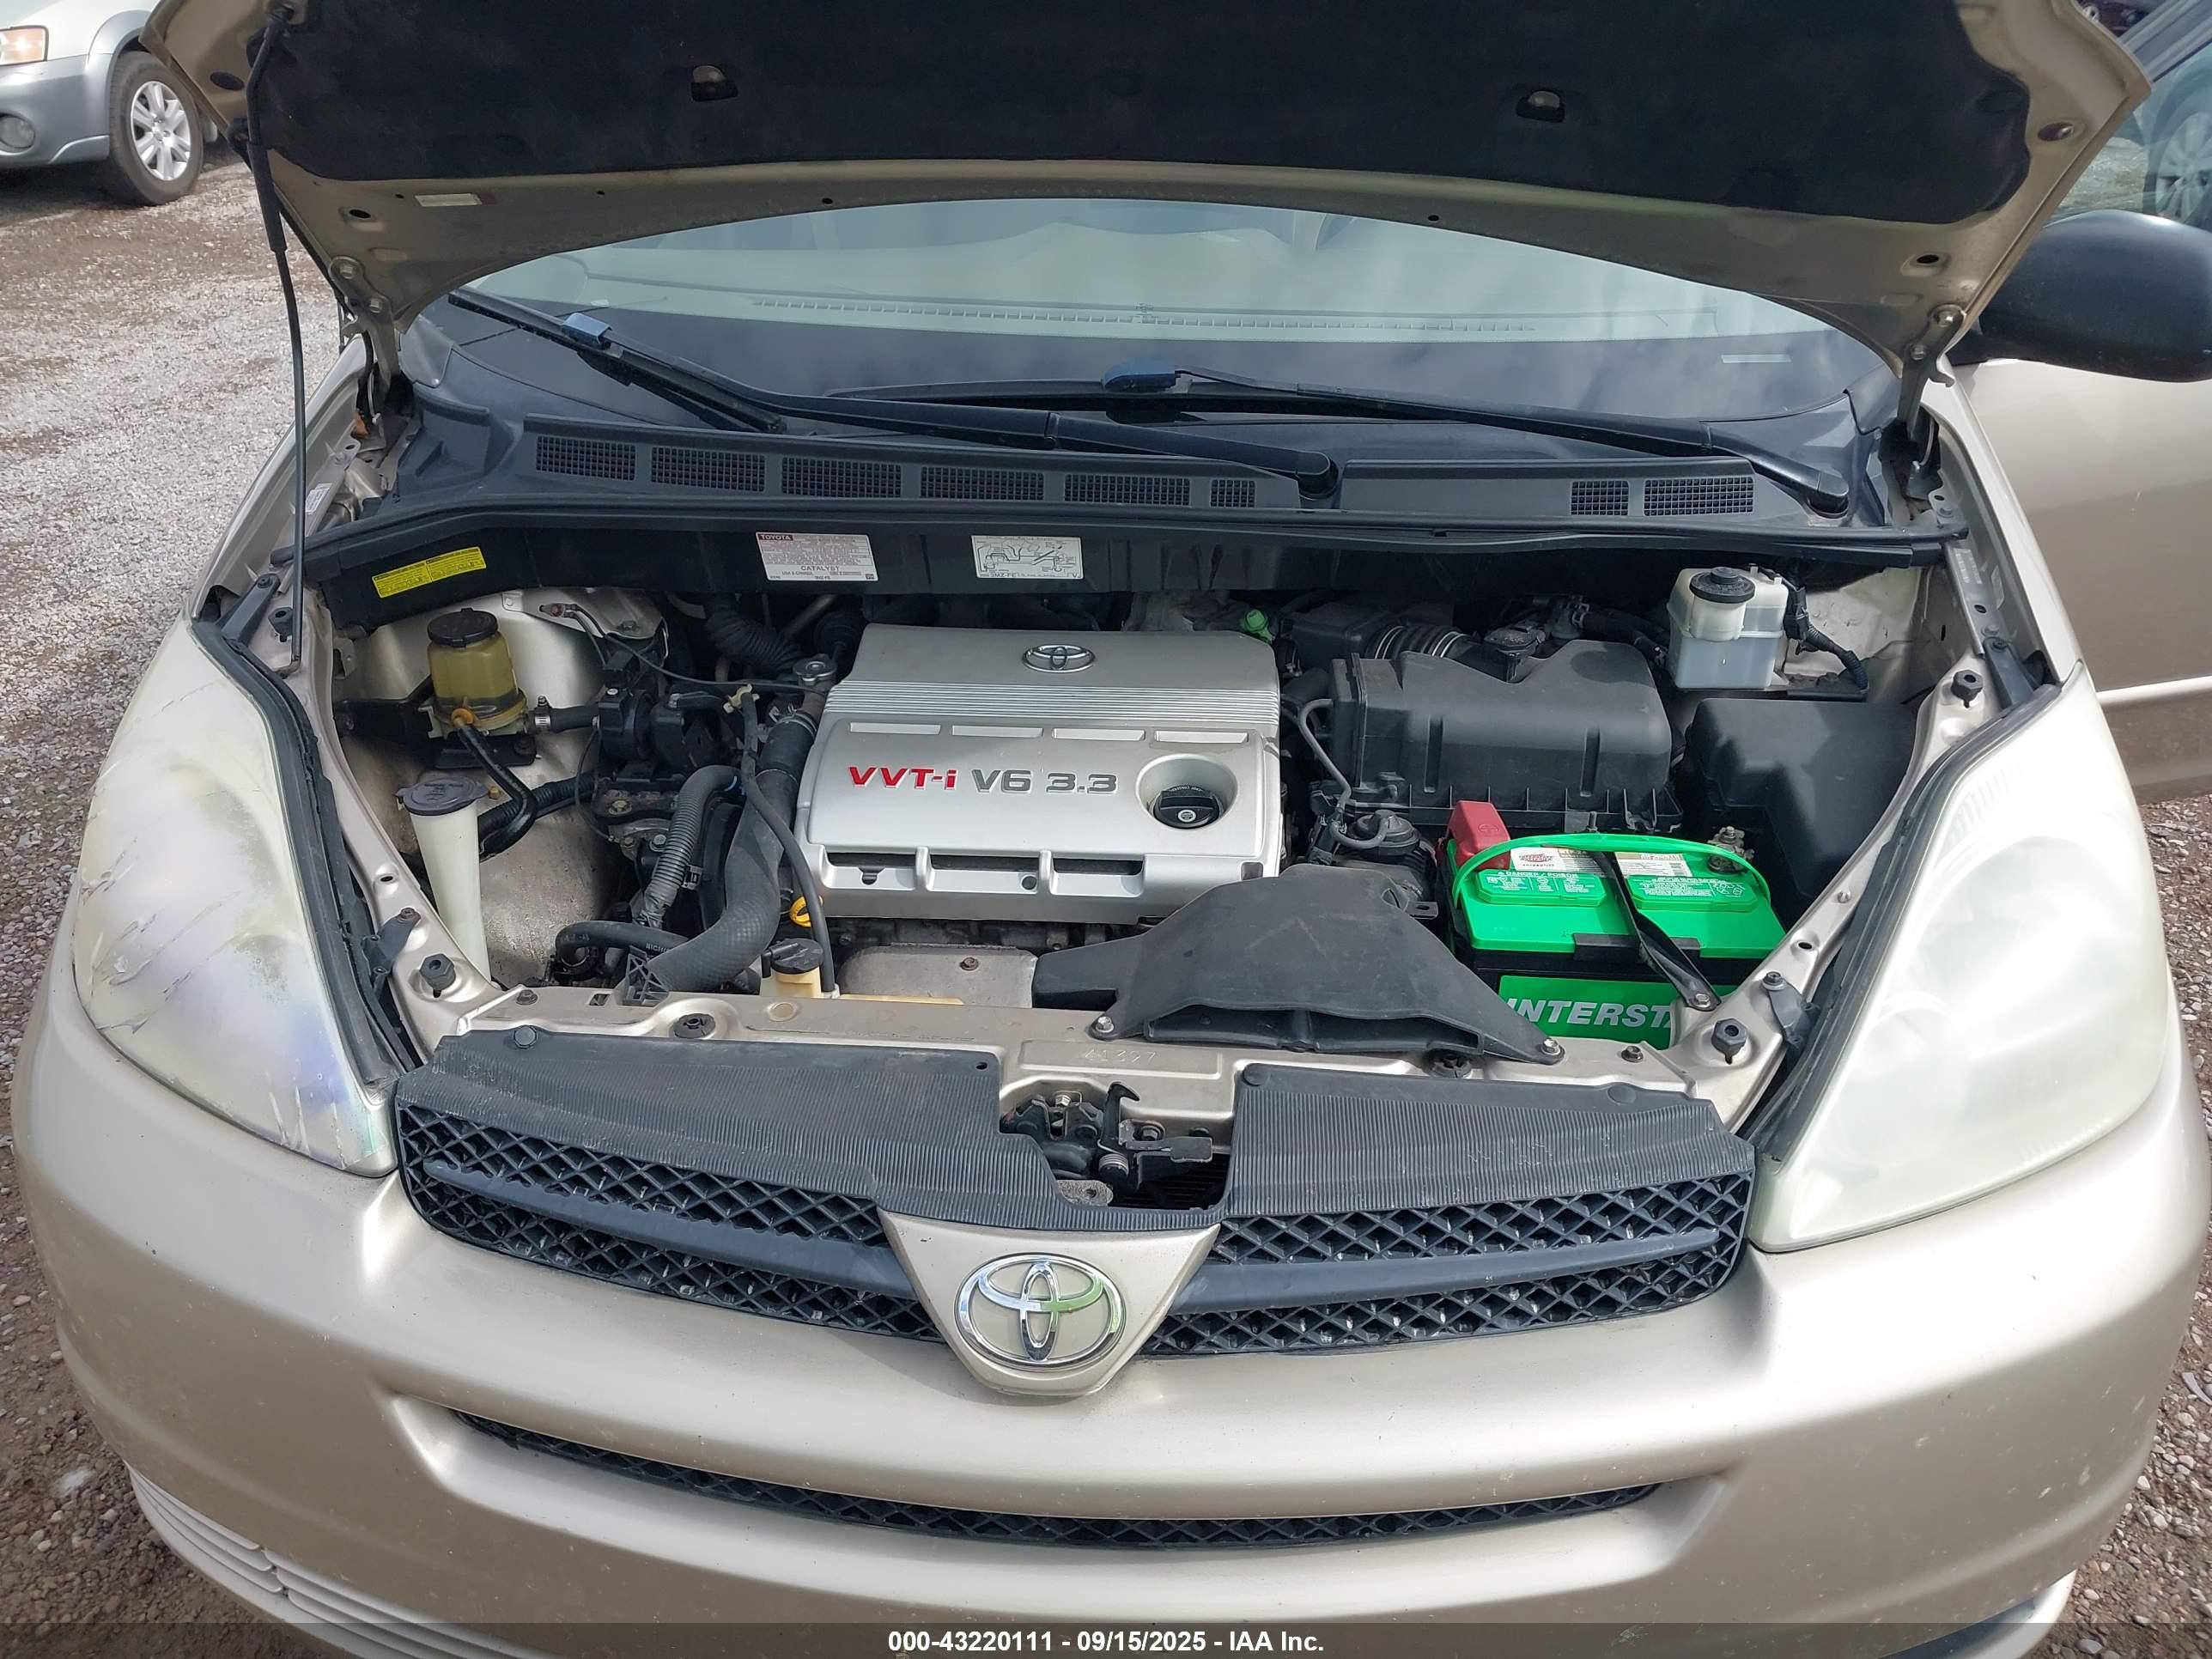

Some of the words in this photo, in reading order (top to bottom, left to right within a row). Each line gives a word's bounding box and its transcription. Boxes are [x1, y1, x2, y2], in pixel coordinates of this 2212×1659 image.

[848, 766, 958, 790] VVT-i
[971, 769, 1033, 793] V6
[1045, 772, 1118, 795] 3.3
[1507, 998, 1671, 1029] NTERST
